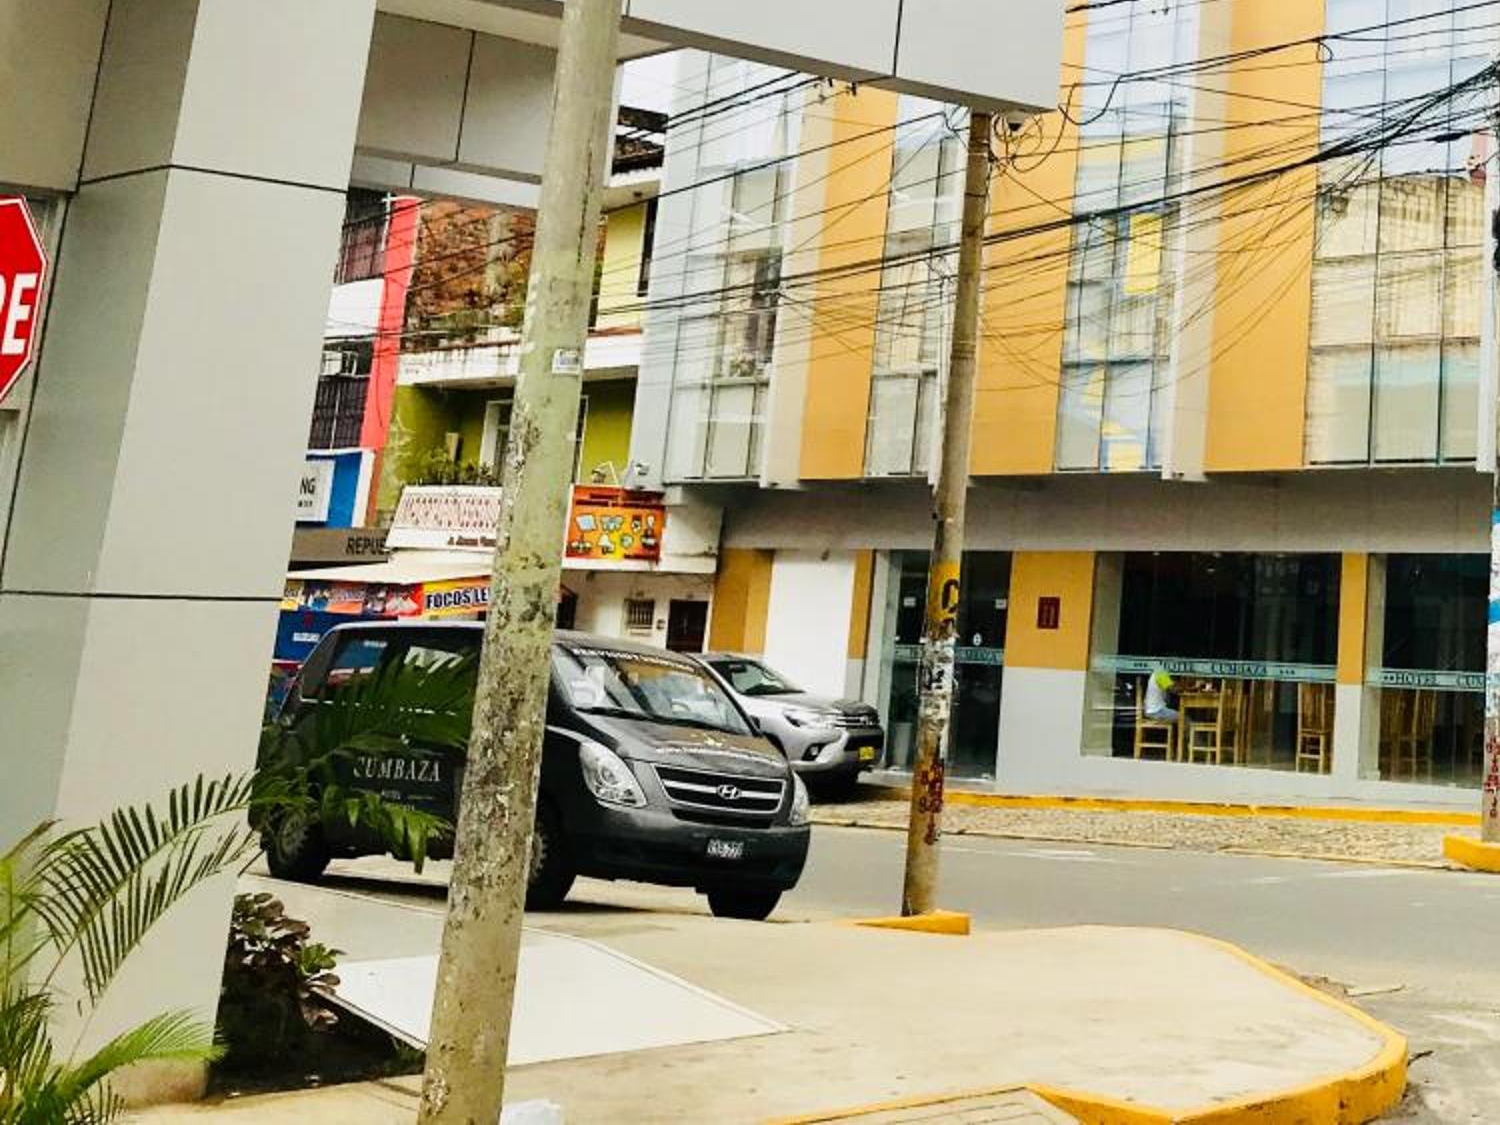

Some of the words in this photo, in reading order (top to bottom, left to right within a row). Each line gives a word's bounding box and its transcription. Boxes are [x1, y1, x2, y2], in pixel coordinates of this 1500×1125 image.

[0, 272, 38, 356] E
[425, 588, 471, 610] FOCOS
[353, 756, 441, 782] CUMBAZA
